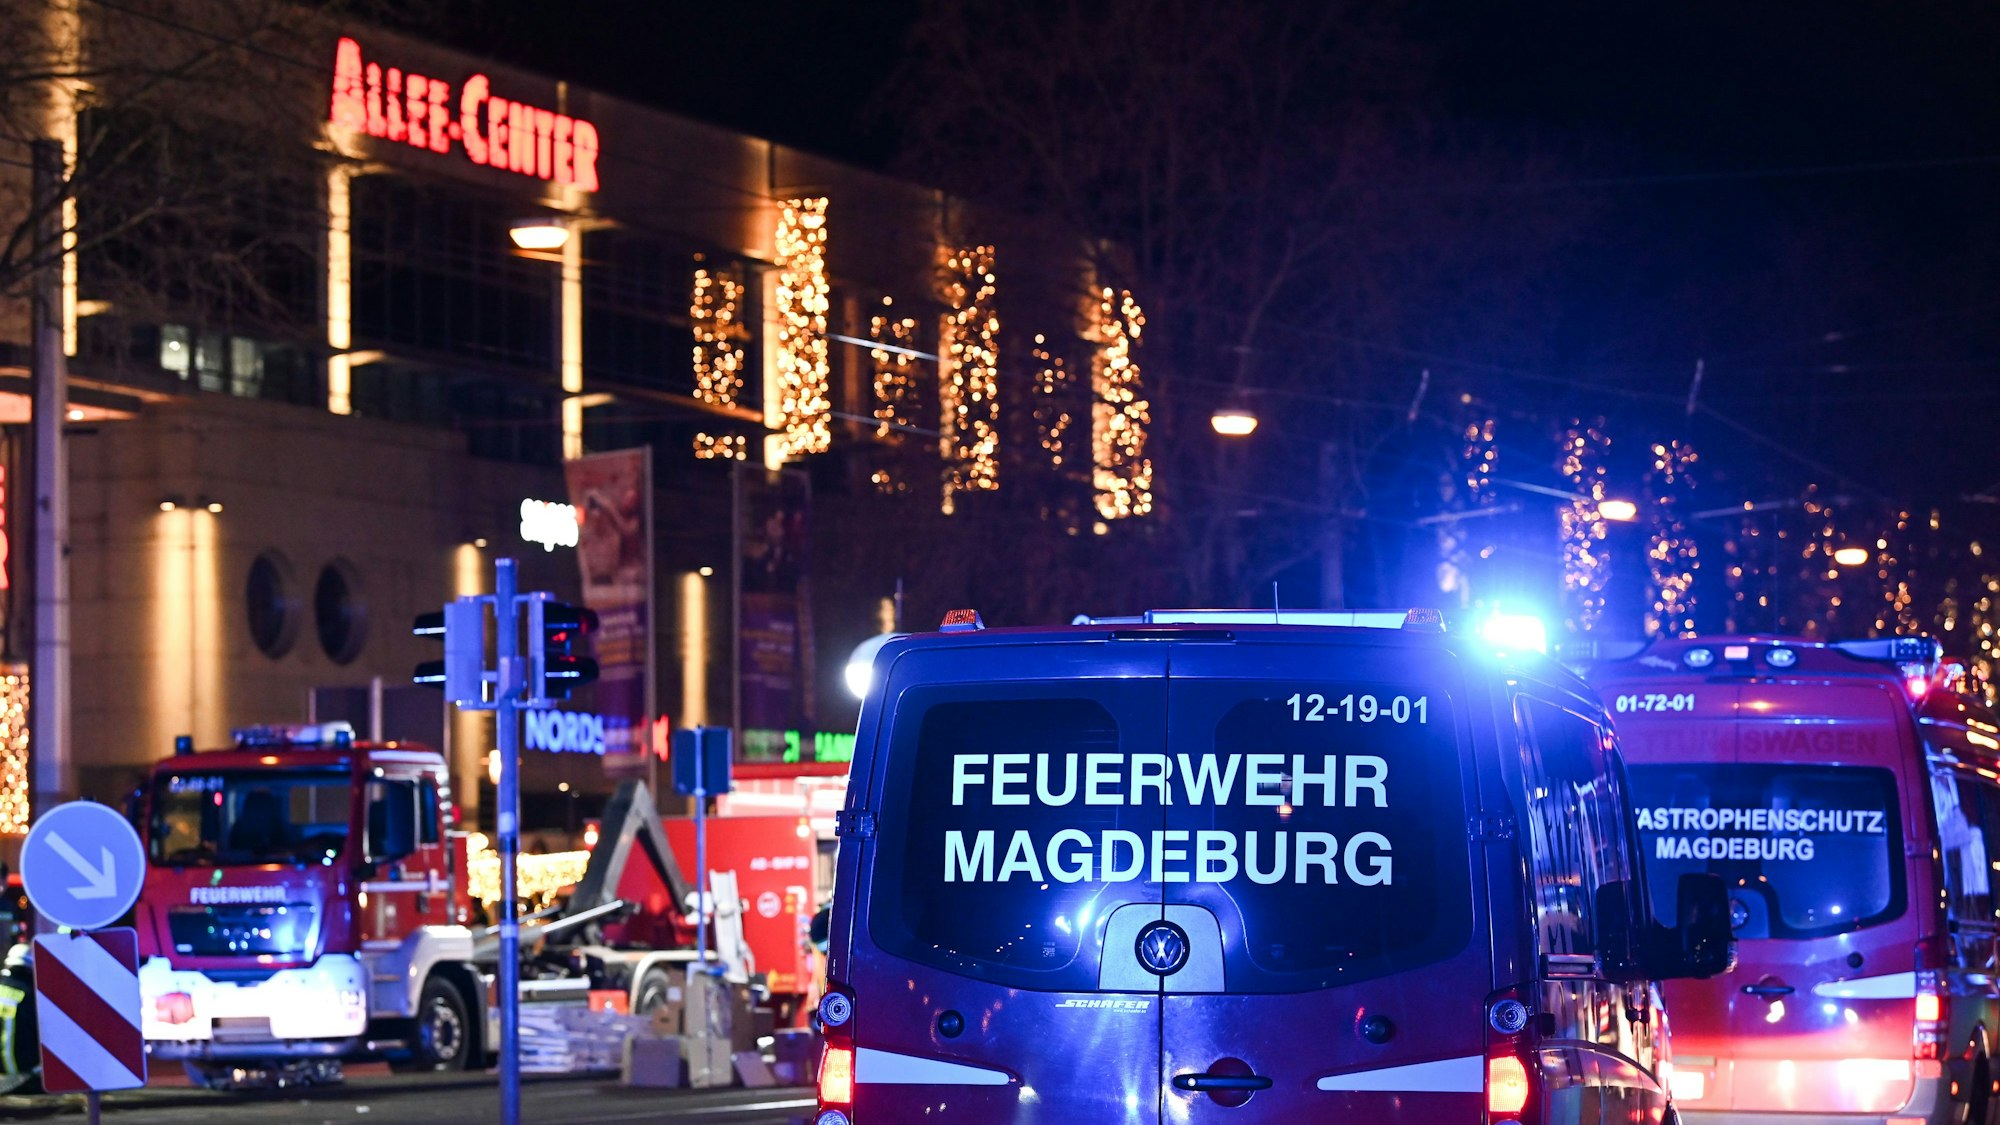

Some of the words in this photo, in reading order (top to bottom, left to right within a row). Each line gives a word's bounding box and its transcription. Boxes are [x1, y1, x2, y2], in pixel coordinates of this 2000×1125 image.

[1286, 692, 1429, 724] 12-19-01
[1615, 693, 1695, 713] 01-72-01
[525, 708, 606, 756] NORDS
[951, 752, 1390, 809] FEUERWEHR
[1634, 807, 1884, 834] ASTROPHENSCHUTZ
[943, 828, 1394, 887] MAGDEBURG
[1655, 836, 1815, 861] MAGDEBURG
[190, 886, 286, 904] FEUERWEHR
